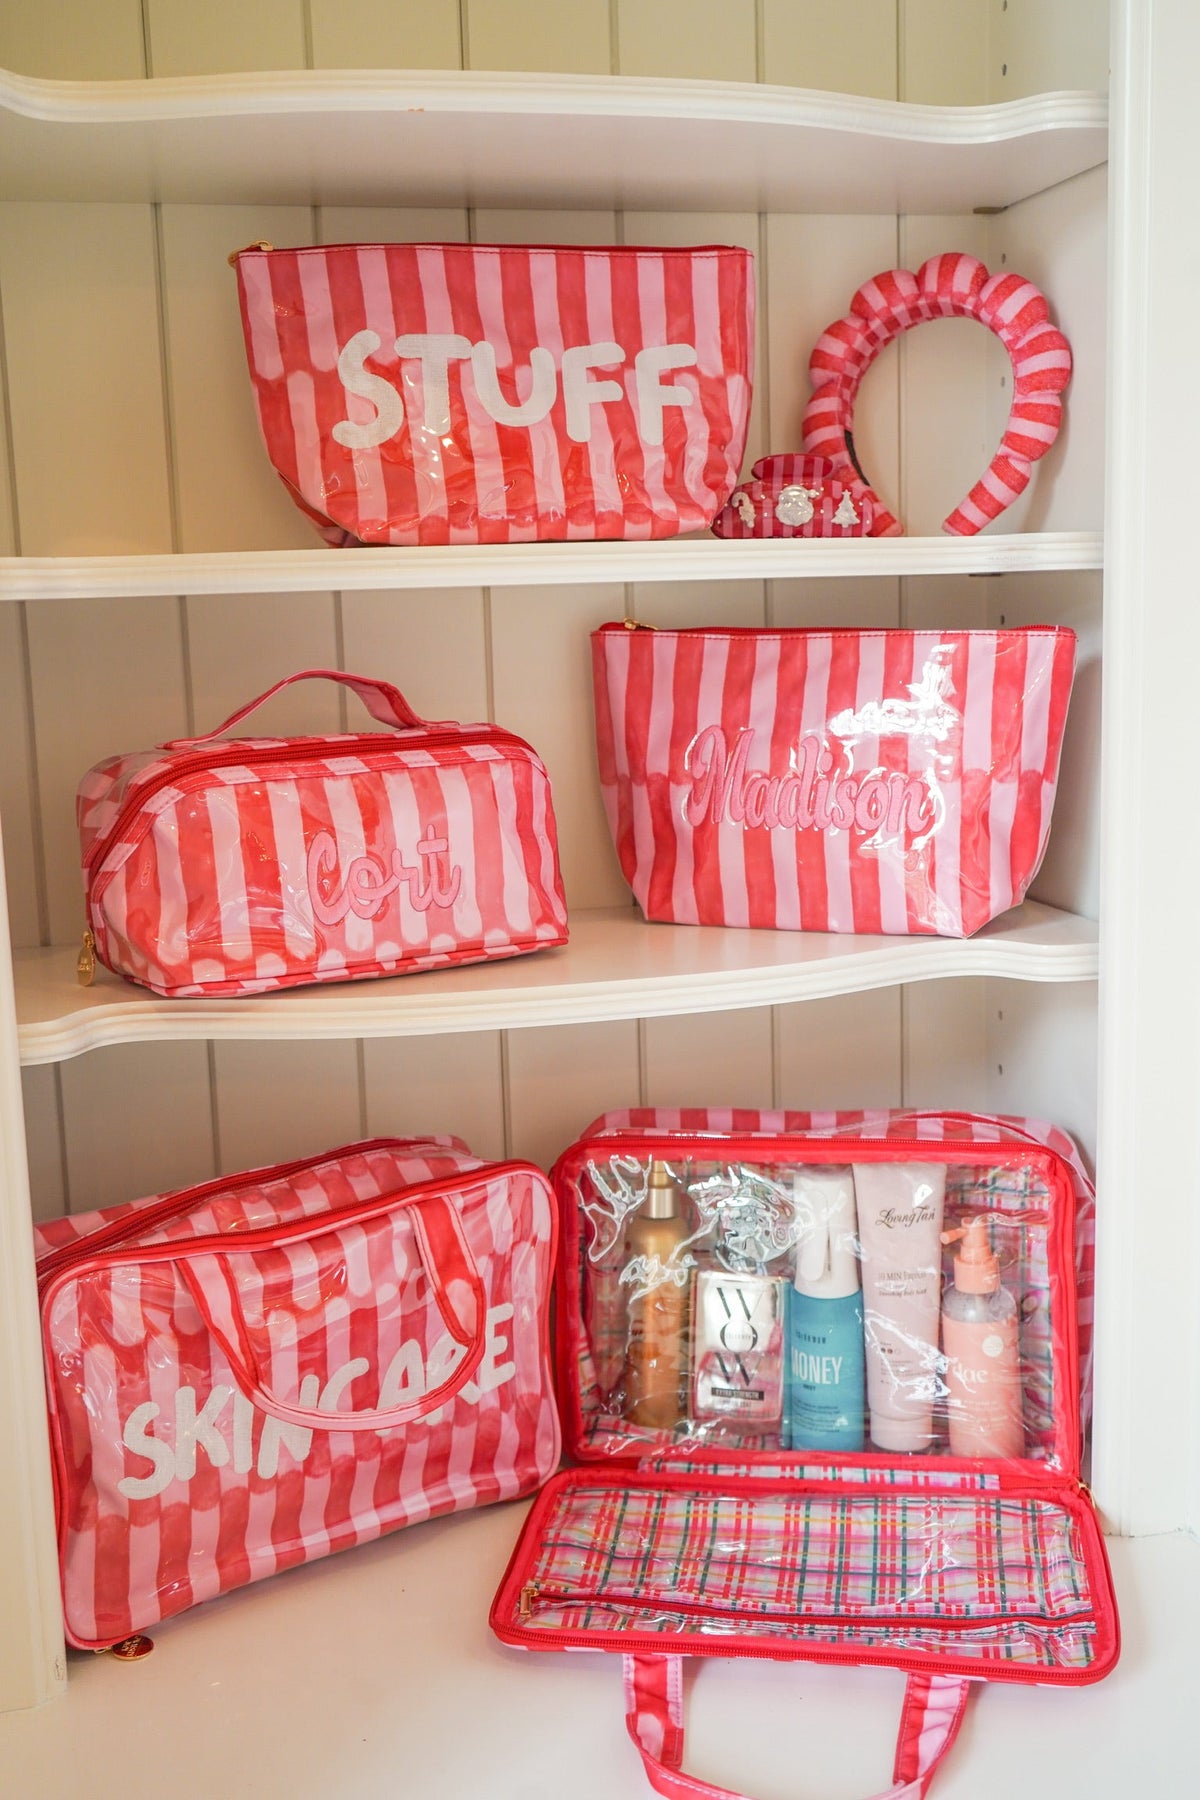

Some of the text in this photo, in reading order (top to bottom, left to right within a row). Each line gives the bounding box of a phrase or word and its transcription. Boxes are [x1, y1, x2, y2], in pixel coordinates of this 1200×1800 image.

[332, 329, 697, 449] STUFF
[686, 724, 933, 833] Madison
[307, 824, 461, 926] Cort
[875, 1207, 916, 1229] Loving
[117, 1303, 516, 1500] SKINCARE
